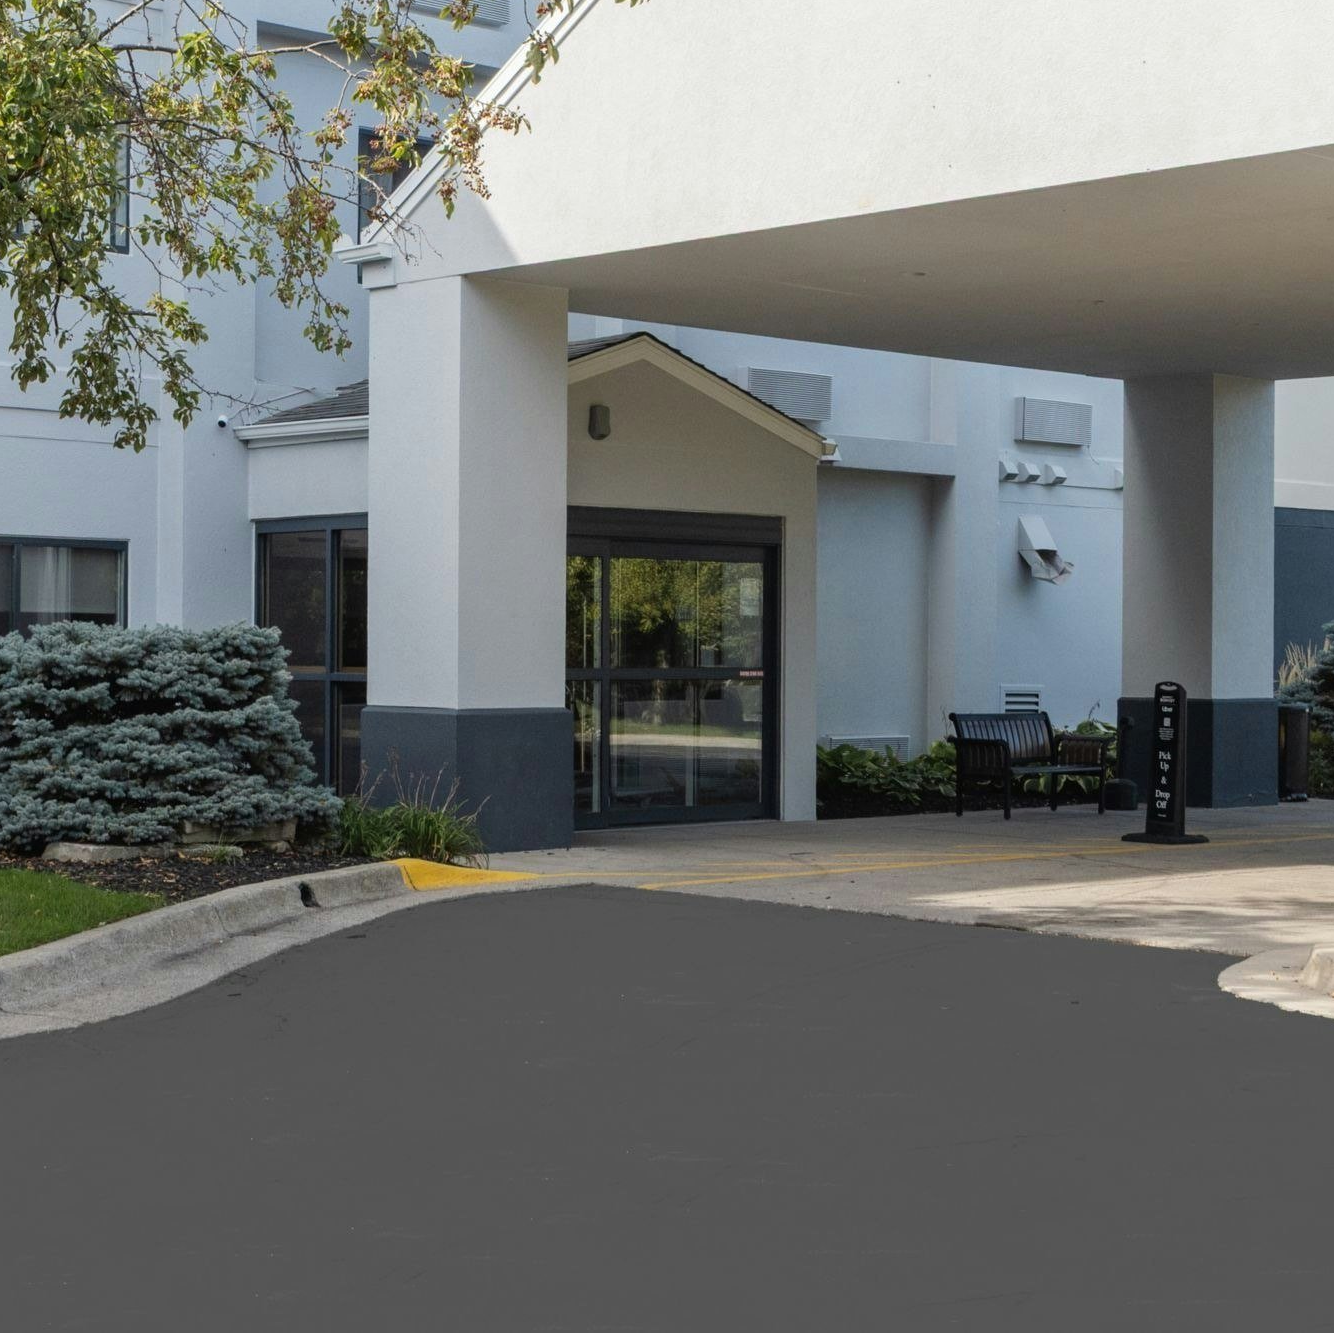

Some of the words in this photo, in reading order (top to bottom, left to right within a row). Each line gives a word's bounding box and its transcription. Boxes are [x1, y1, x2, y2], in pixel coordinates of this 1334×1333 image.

[1158, 751, 1172, 760] Pick
[1160, 761, 1170, 772] Up
[1160, 776, 1167, 784] &
[1155, 789, 1170, 801] Drop
[1156, 800, 1167, 809] Off
